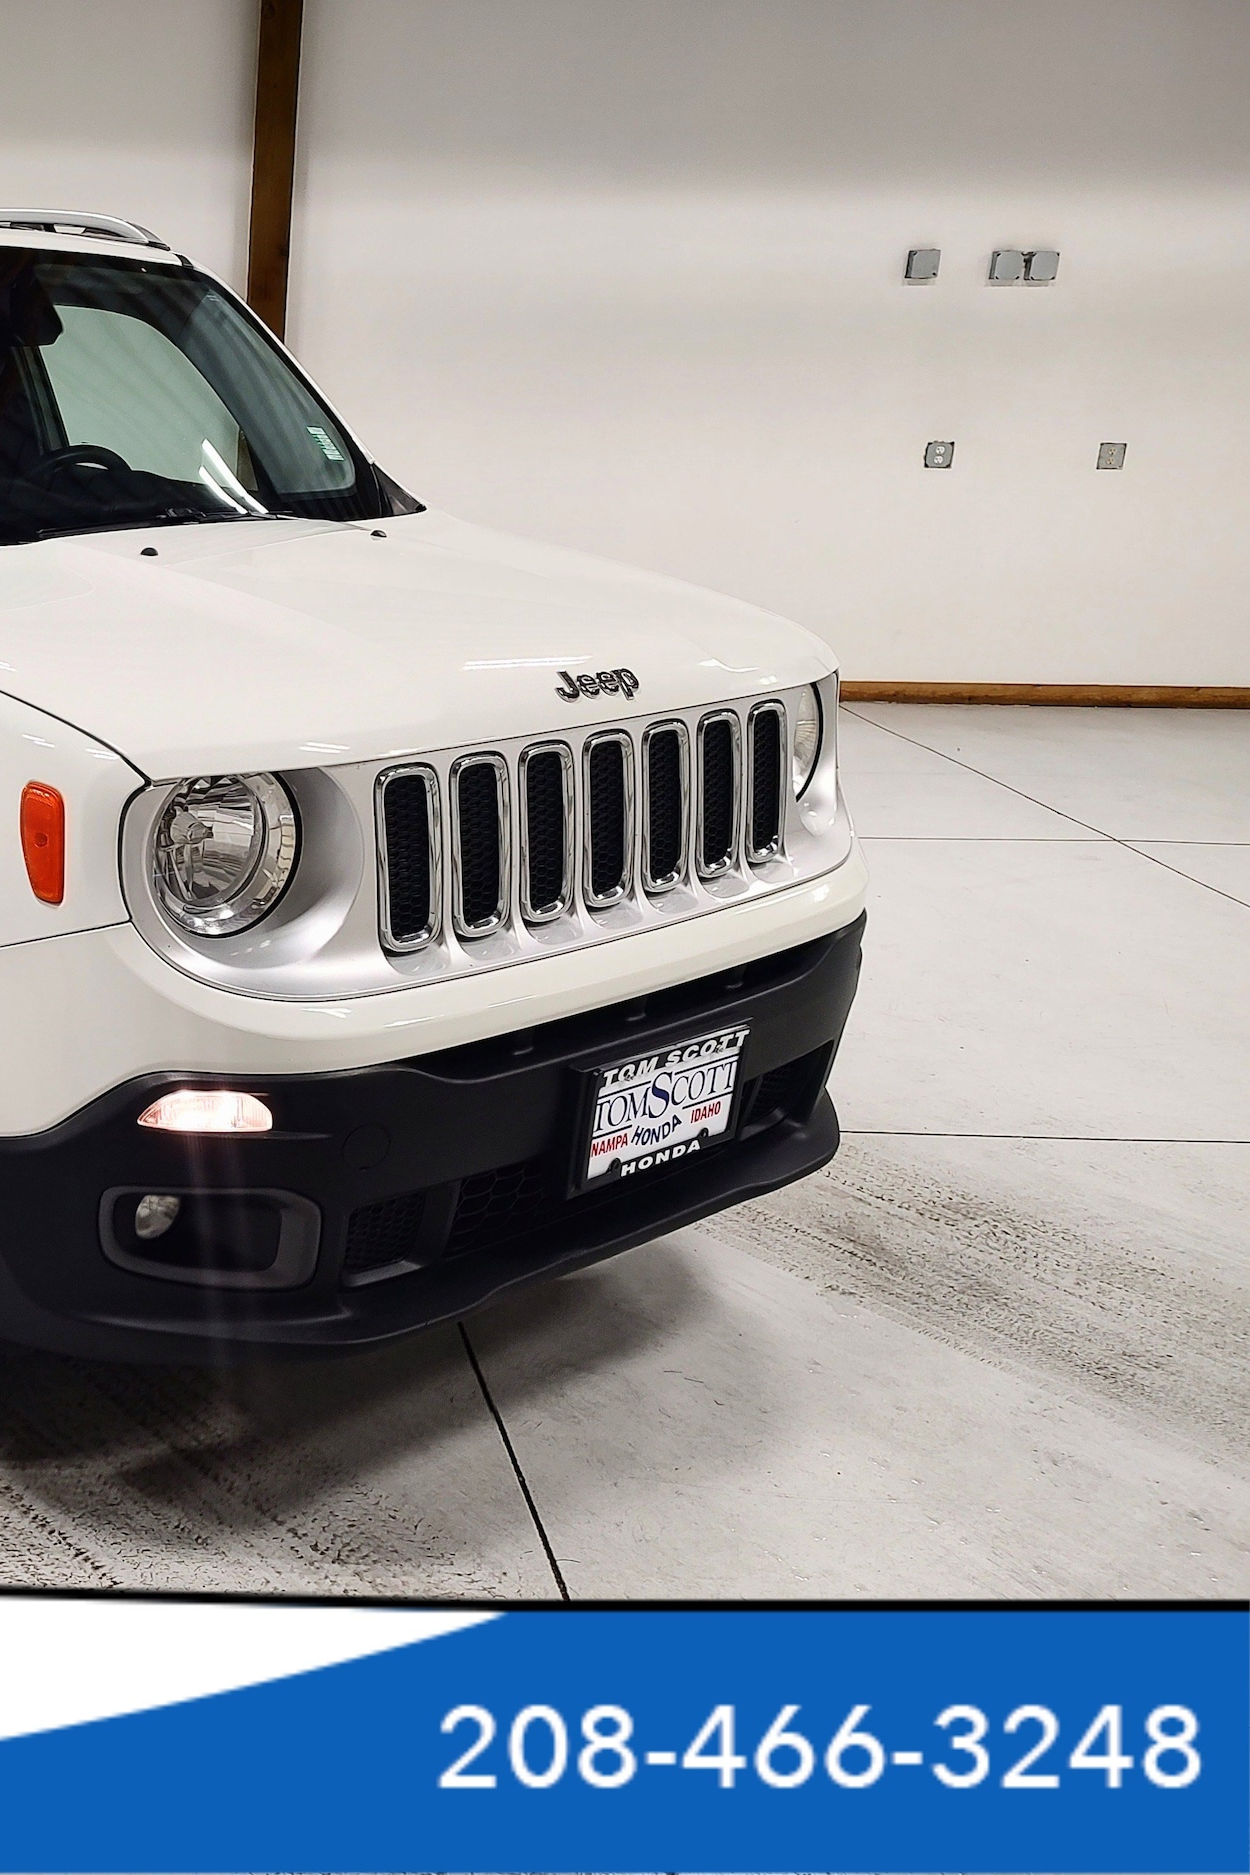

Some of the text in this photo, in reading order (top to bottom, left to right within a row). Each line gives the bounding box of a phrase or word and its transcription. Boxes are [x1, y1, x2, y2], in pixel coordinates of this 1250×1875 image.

[555, 668, 639, 703] Jeep
[603, 1029, 750, 1088] TOM SCOTT
[690, 1101, 721, 1124] IDAHO
[590, 1133, 628, 1157] NAMPA
[631, 1115, 682, 1146] HONDA
[621, 1140, 700, 1177] HONDA
